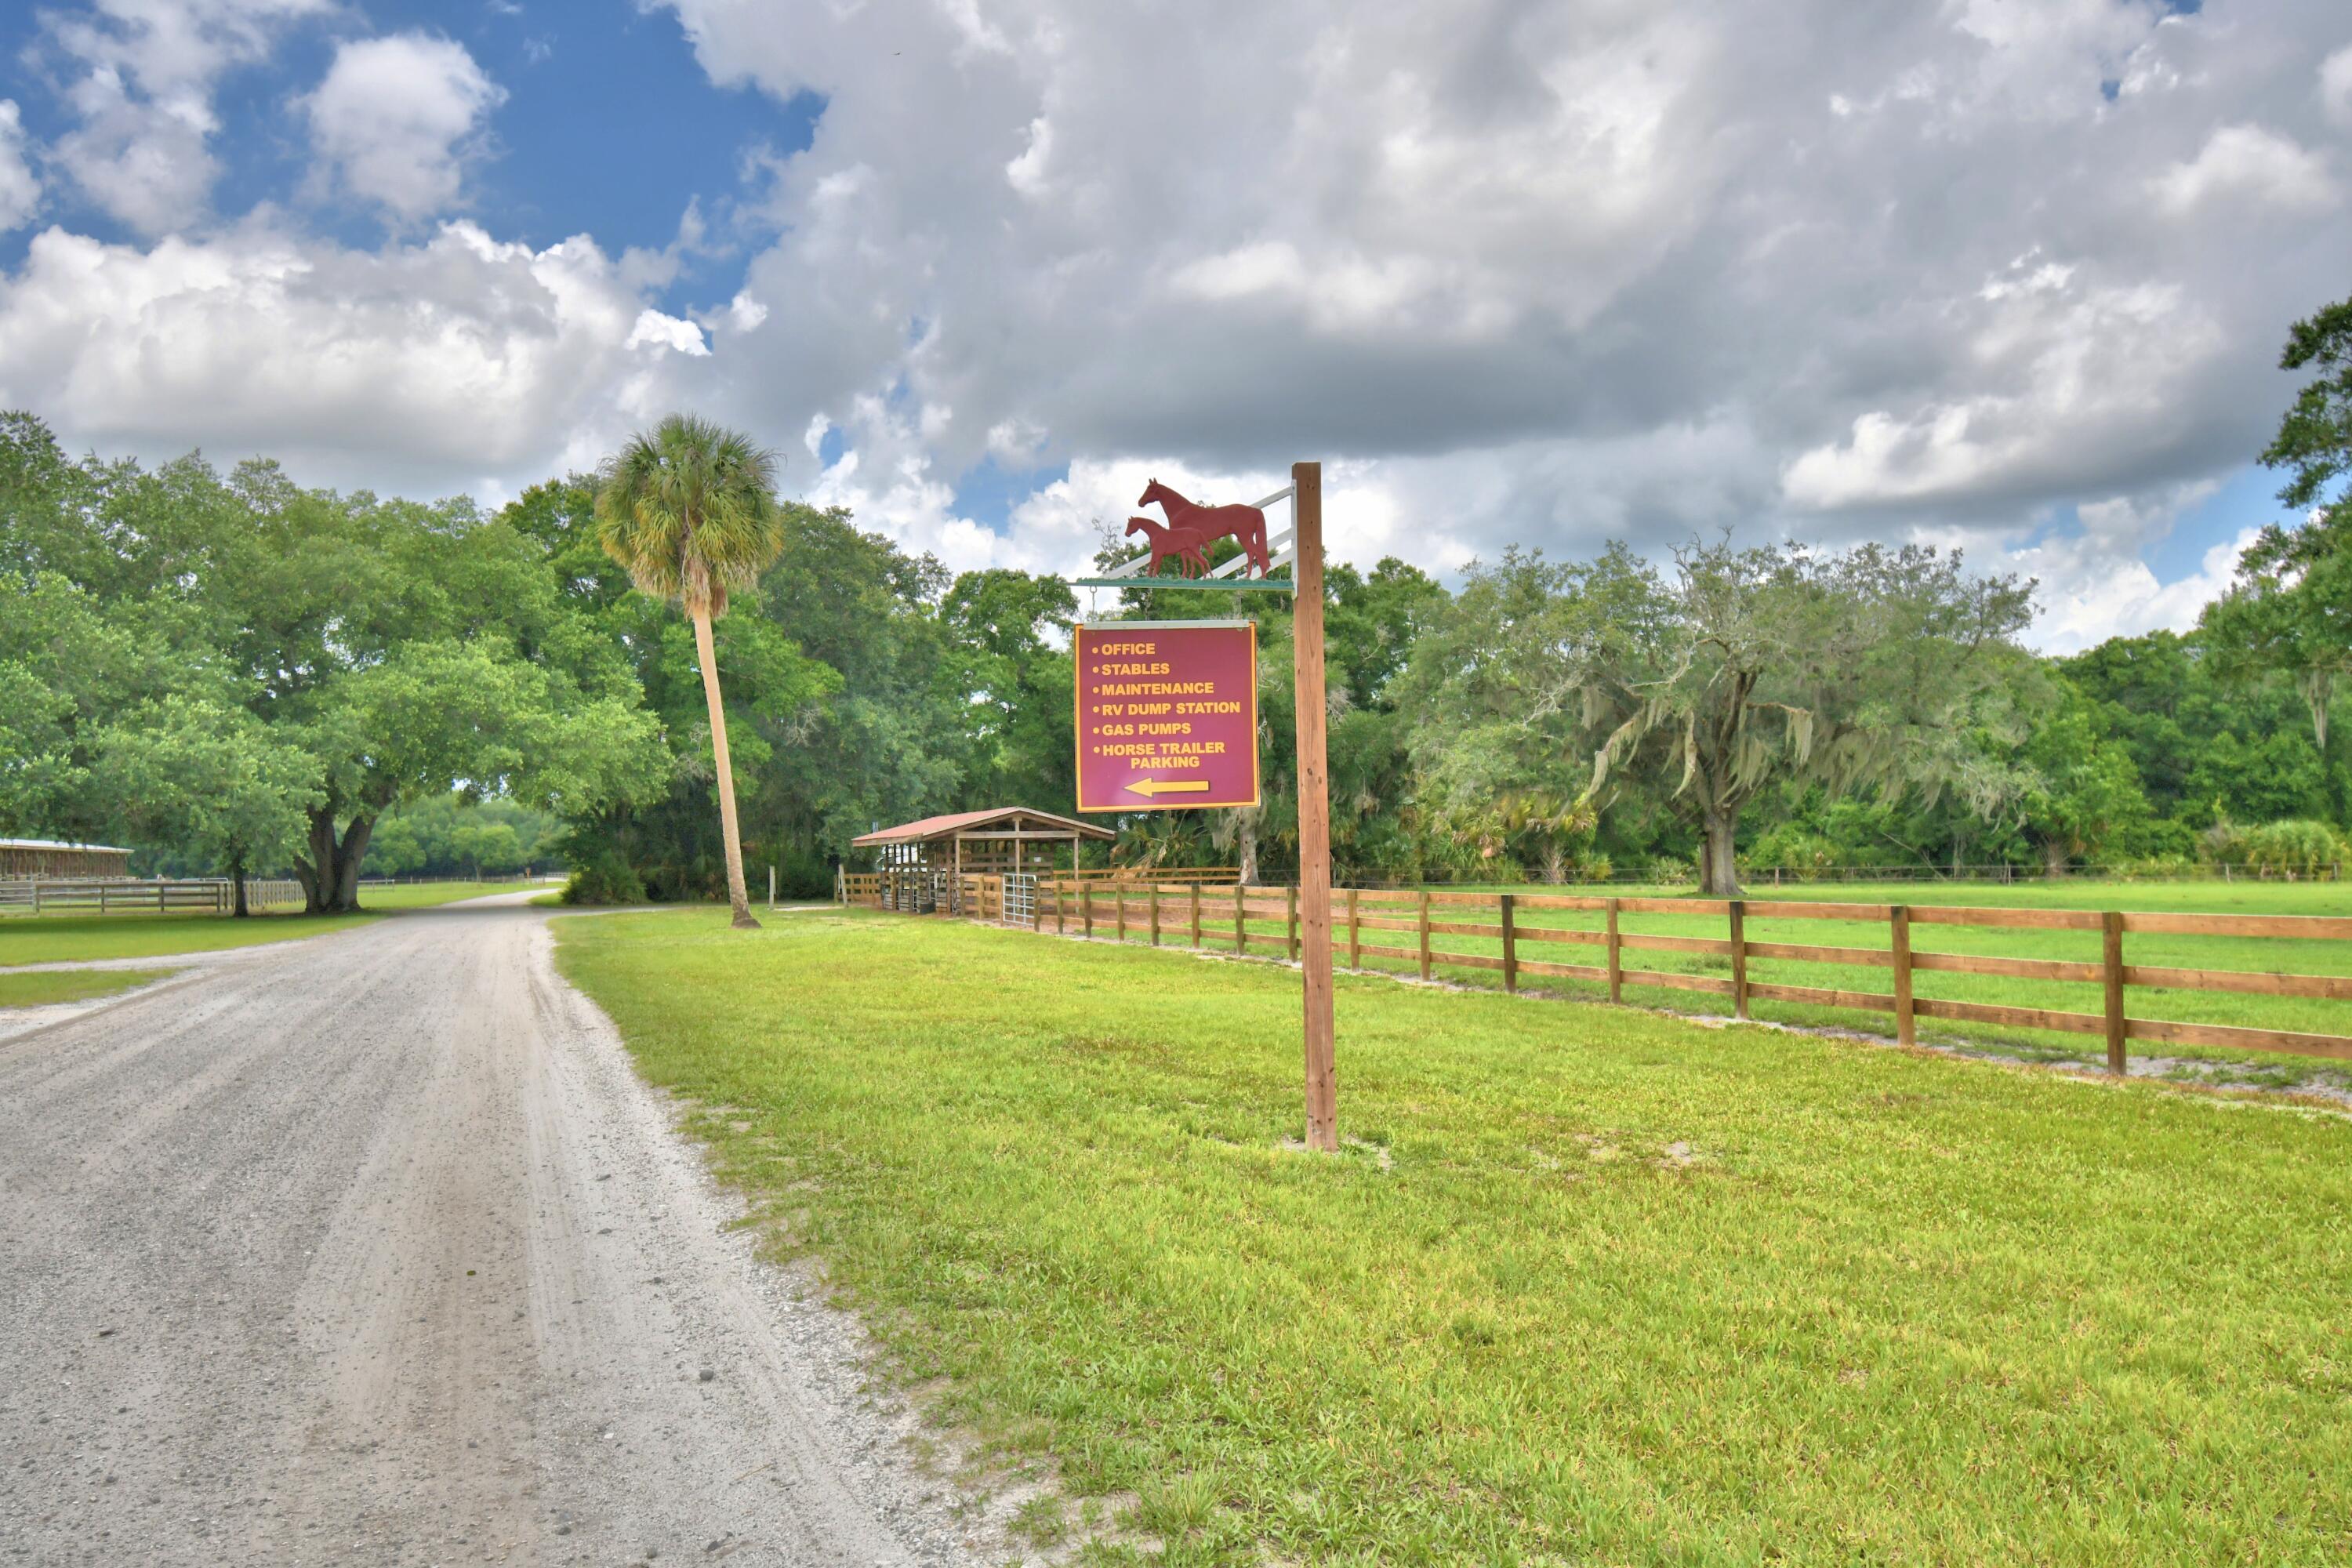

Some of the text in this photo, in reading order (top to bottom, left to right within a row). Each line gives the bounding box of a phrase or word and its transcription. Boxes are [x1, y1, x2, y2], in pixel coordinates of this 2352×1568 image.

[1102, 644, 1155, 655] OFFICE
[1102, 663, 1170, 675] STABLES
[1102, 682, 1214, 695] MAINTENANCE
[1102, 702, 1240, 716] RV DUMP STATION
[1102, 723, 1191, 735] GAS PUMPS
[1103, 742, 1225, 756] HORSE TRAILER
[1131, 755, 1200, 769] PARKING
